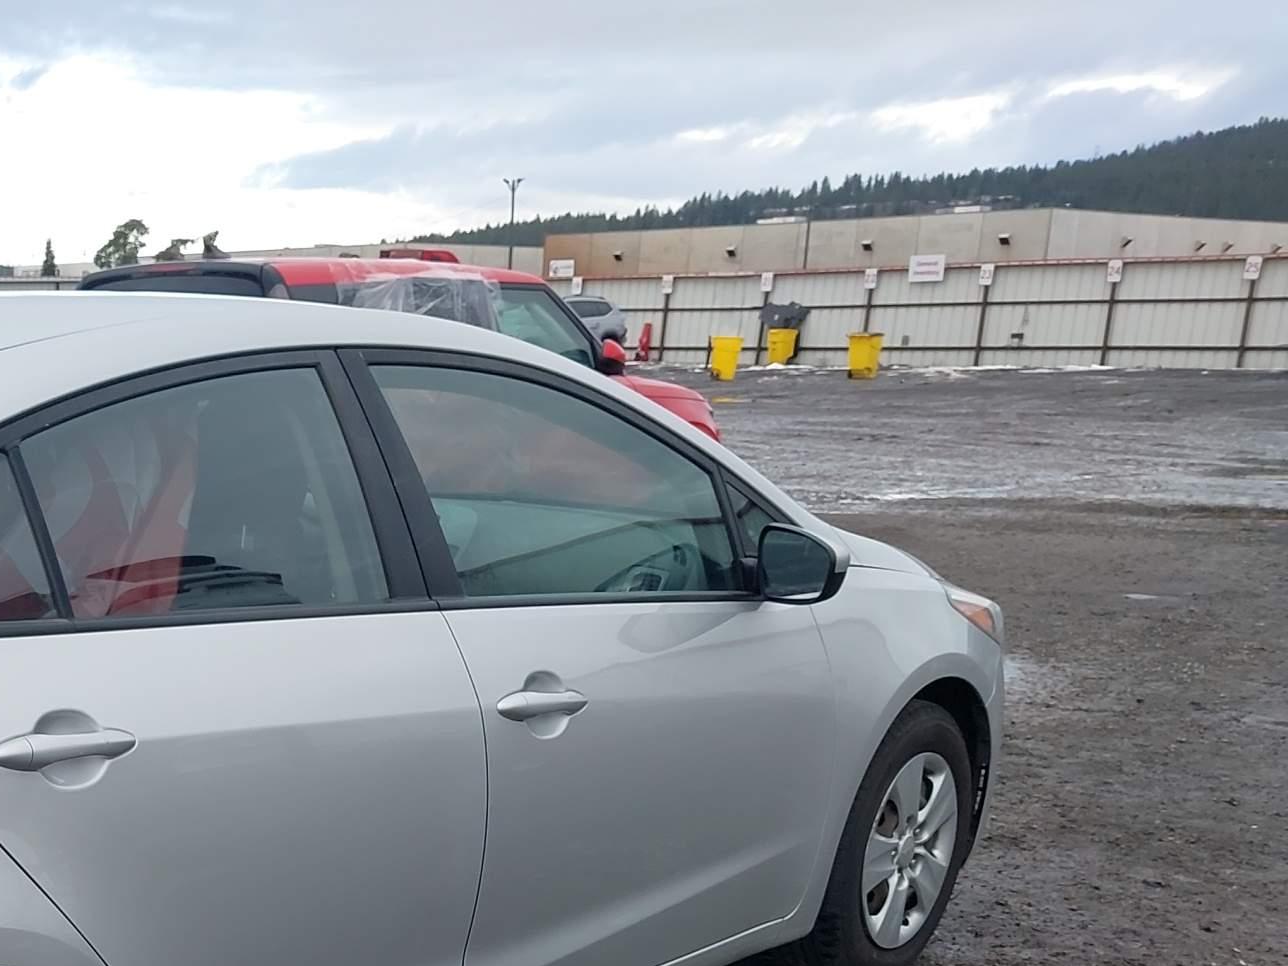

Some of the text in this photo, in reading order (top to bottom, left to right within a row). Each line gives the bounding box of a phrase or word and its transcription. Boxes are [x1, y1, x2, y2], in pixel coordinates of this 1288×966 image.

[1107, 265, 1121, 277] 24
[1244, 261, 1261, 273] 25
[979, 268, 992, 280] 23
